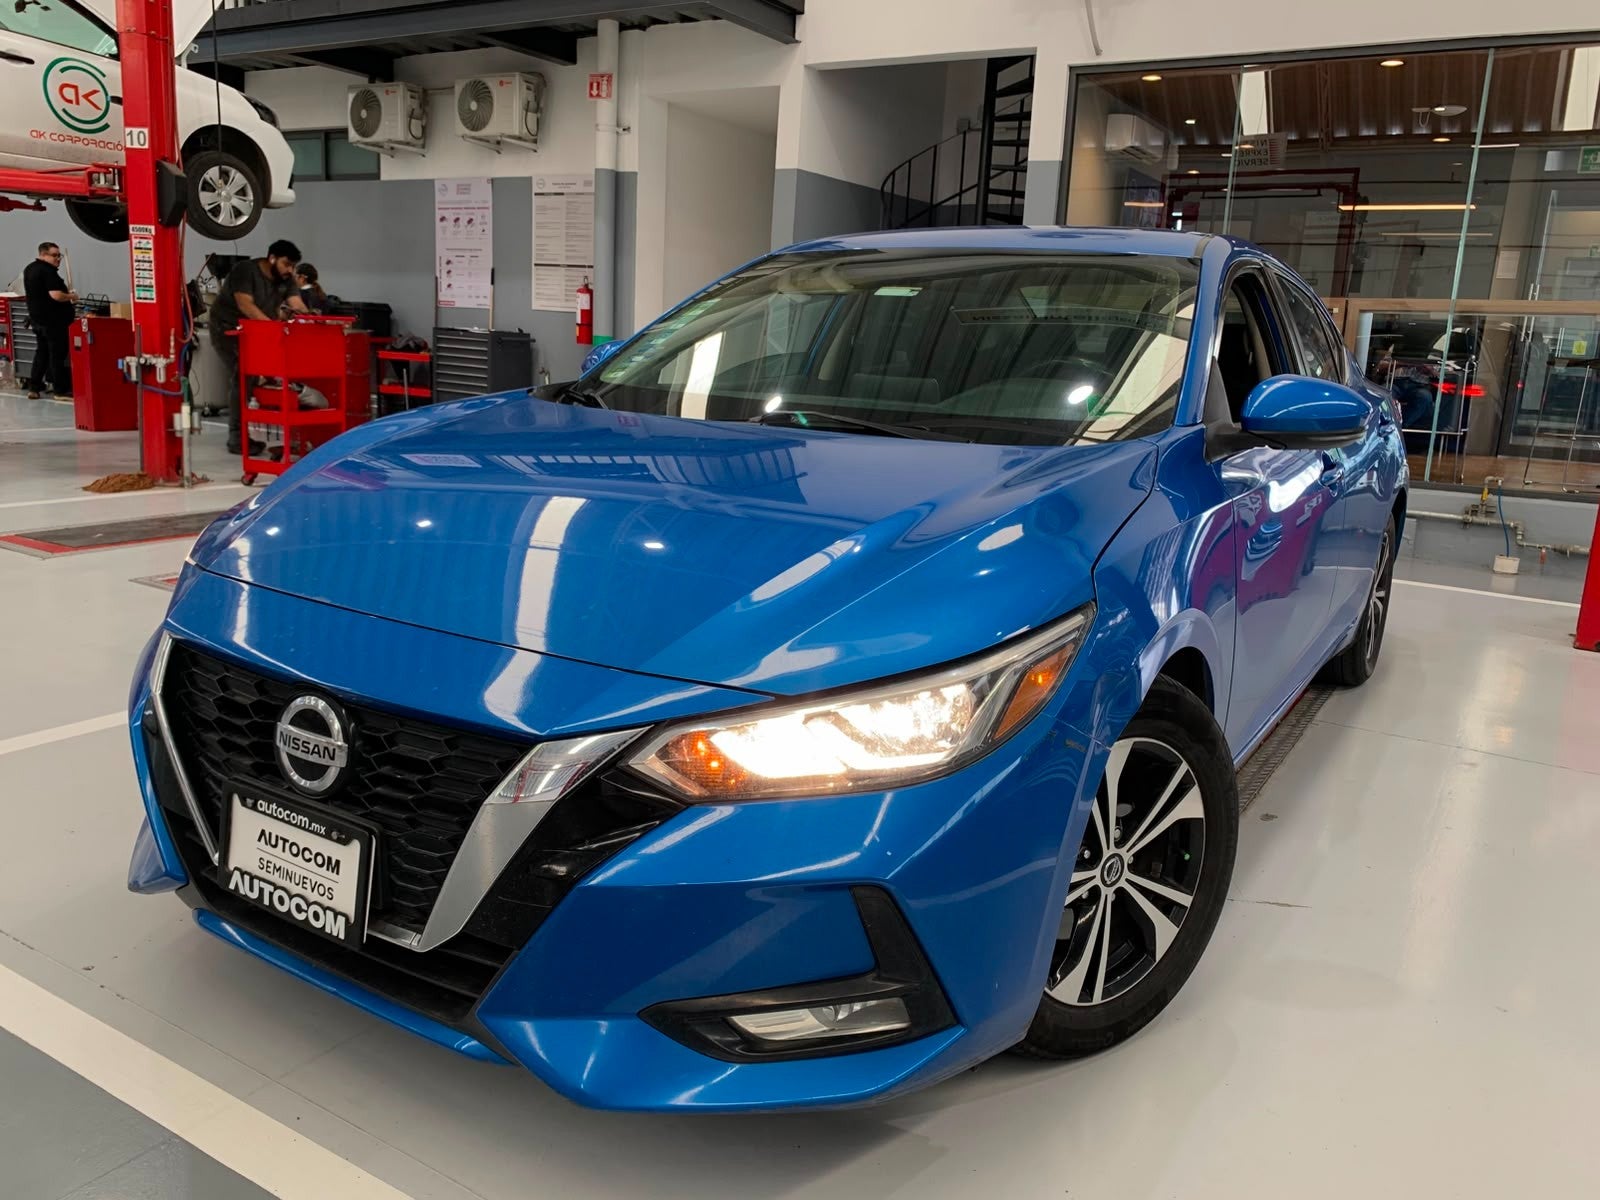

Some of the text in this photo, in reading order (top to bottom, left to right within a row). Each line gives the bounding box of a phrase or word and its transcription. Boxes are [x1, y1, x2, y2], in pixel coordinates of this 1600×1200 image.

[49, 132, 126, 152] CORPORACIÓ
[126, 130, 147, 147] 10
[279, 730, 336, 762] NISSAN
[257, 798, 327, 836] autocom.mx
[257, 828, 341, 876] AUTOCOM
[257, 856, 335, 901] SEMINUEVOS
[228, 869, 347, 941] AUTOCOM
